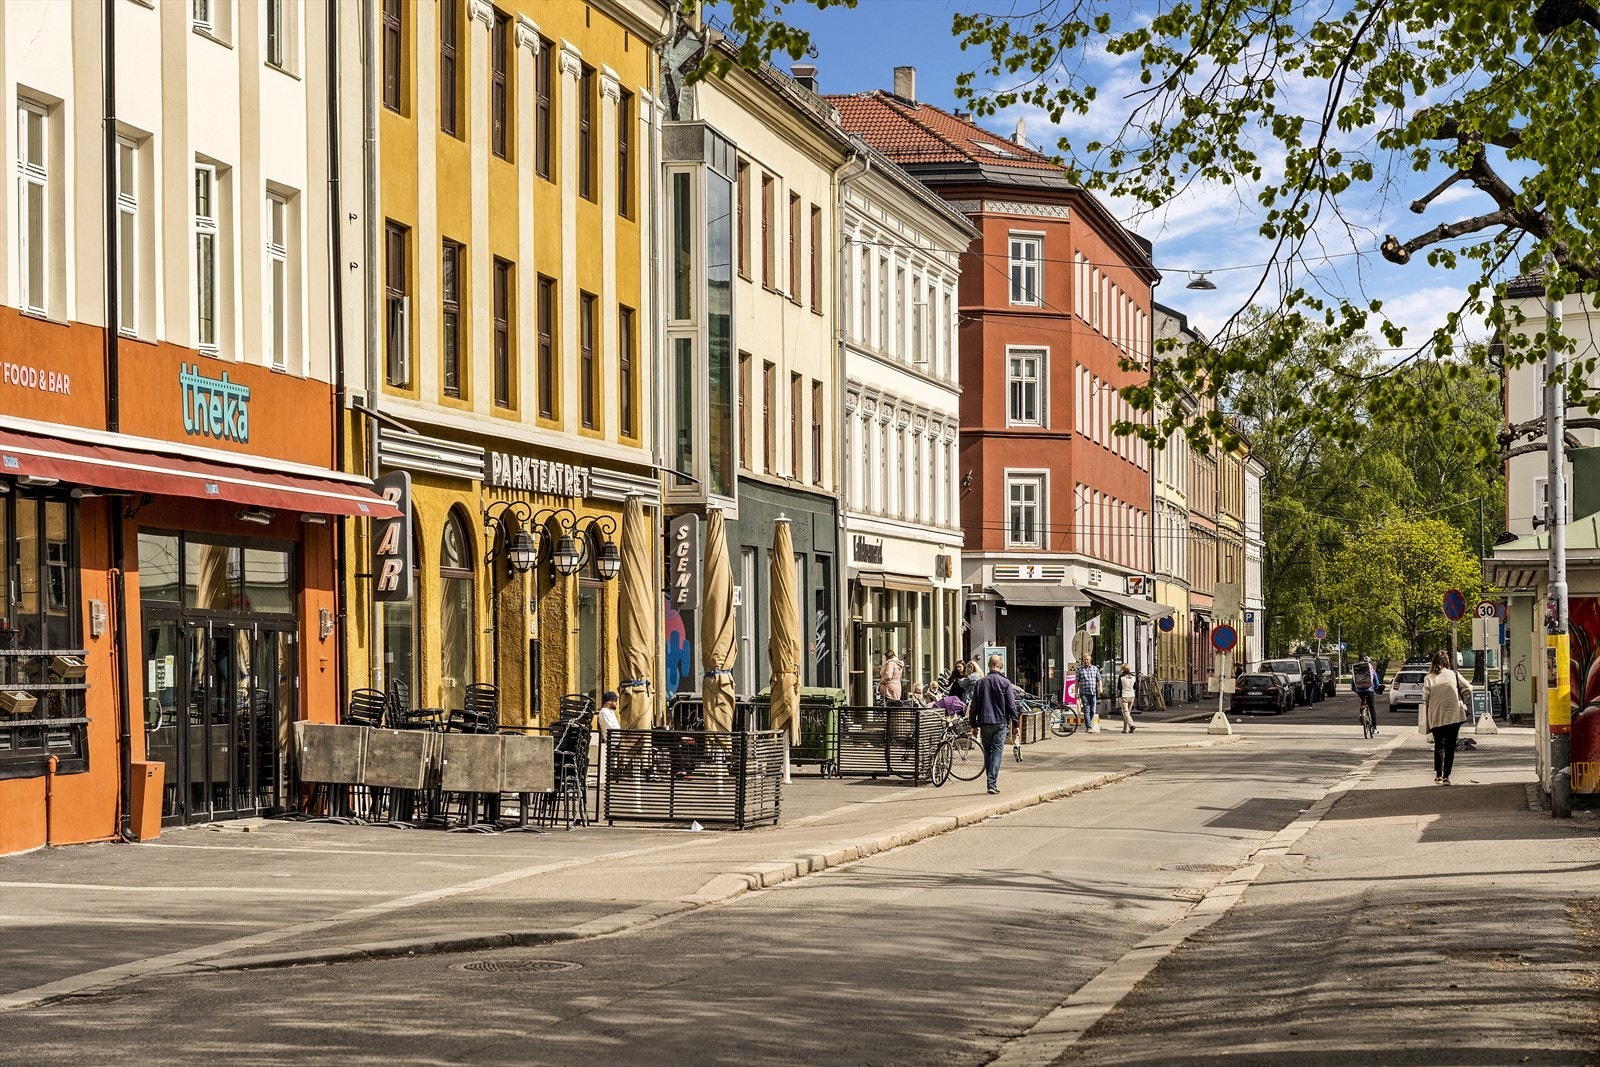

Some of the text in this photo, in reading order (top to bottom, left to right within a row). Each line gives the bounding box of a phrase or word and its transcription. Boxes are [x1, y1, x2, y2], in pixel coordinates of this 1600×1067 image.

[4, 362, 70, 395] FOOD & BAR
[180, 362, 250, 442] theka
[492, 451, 589, 498] PARKTEATRET
[675, 525, 692, 603] SCENE
[1245, 613, 1252, 621] P
[1480, 606, 1494, 616] 30
